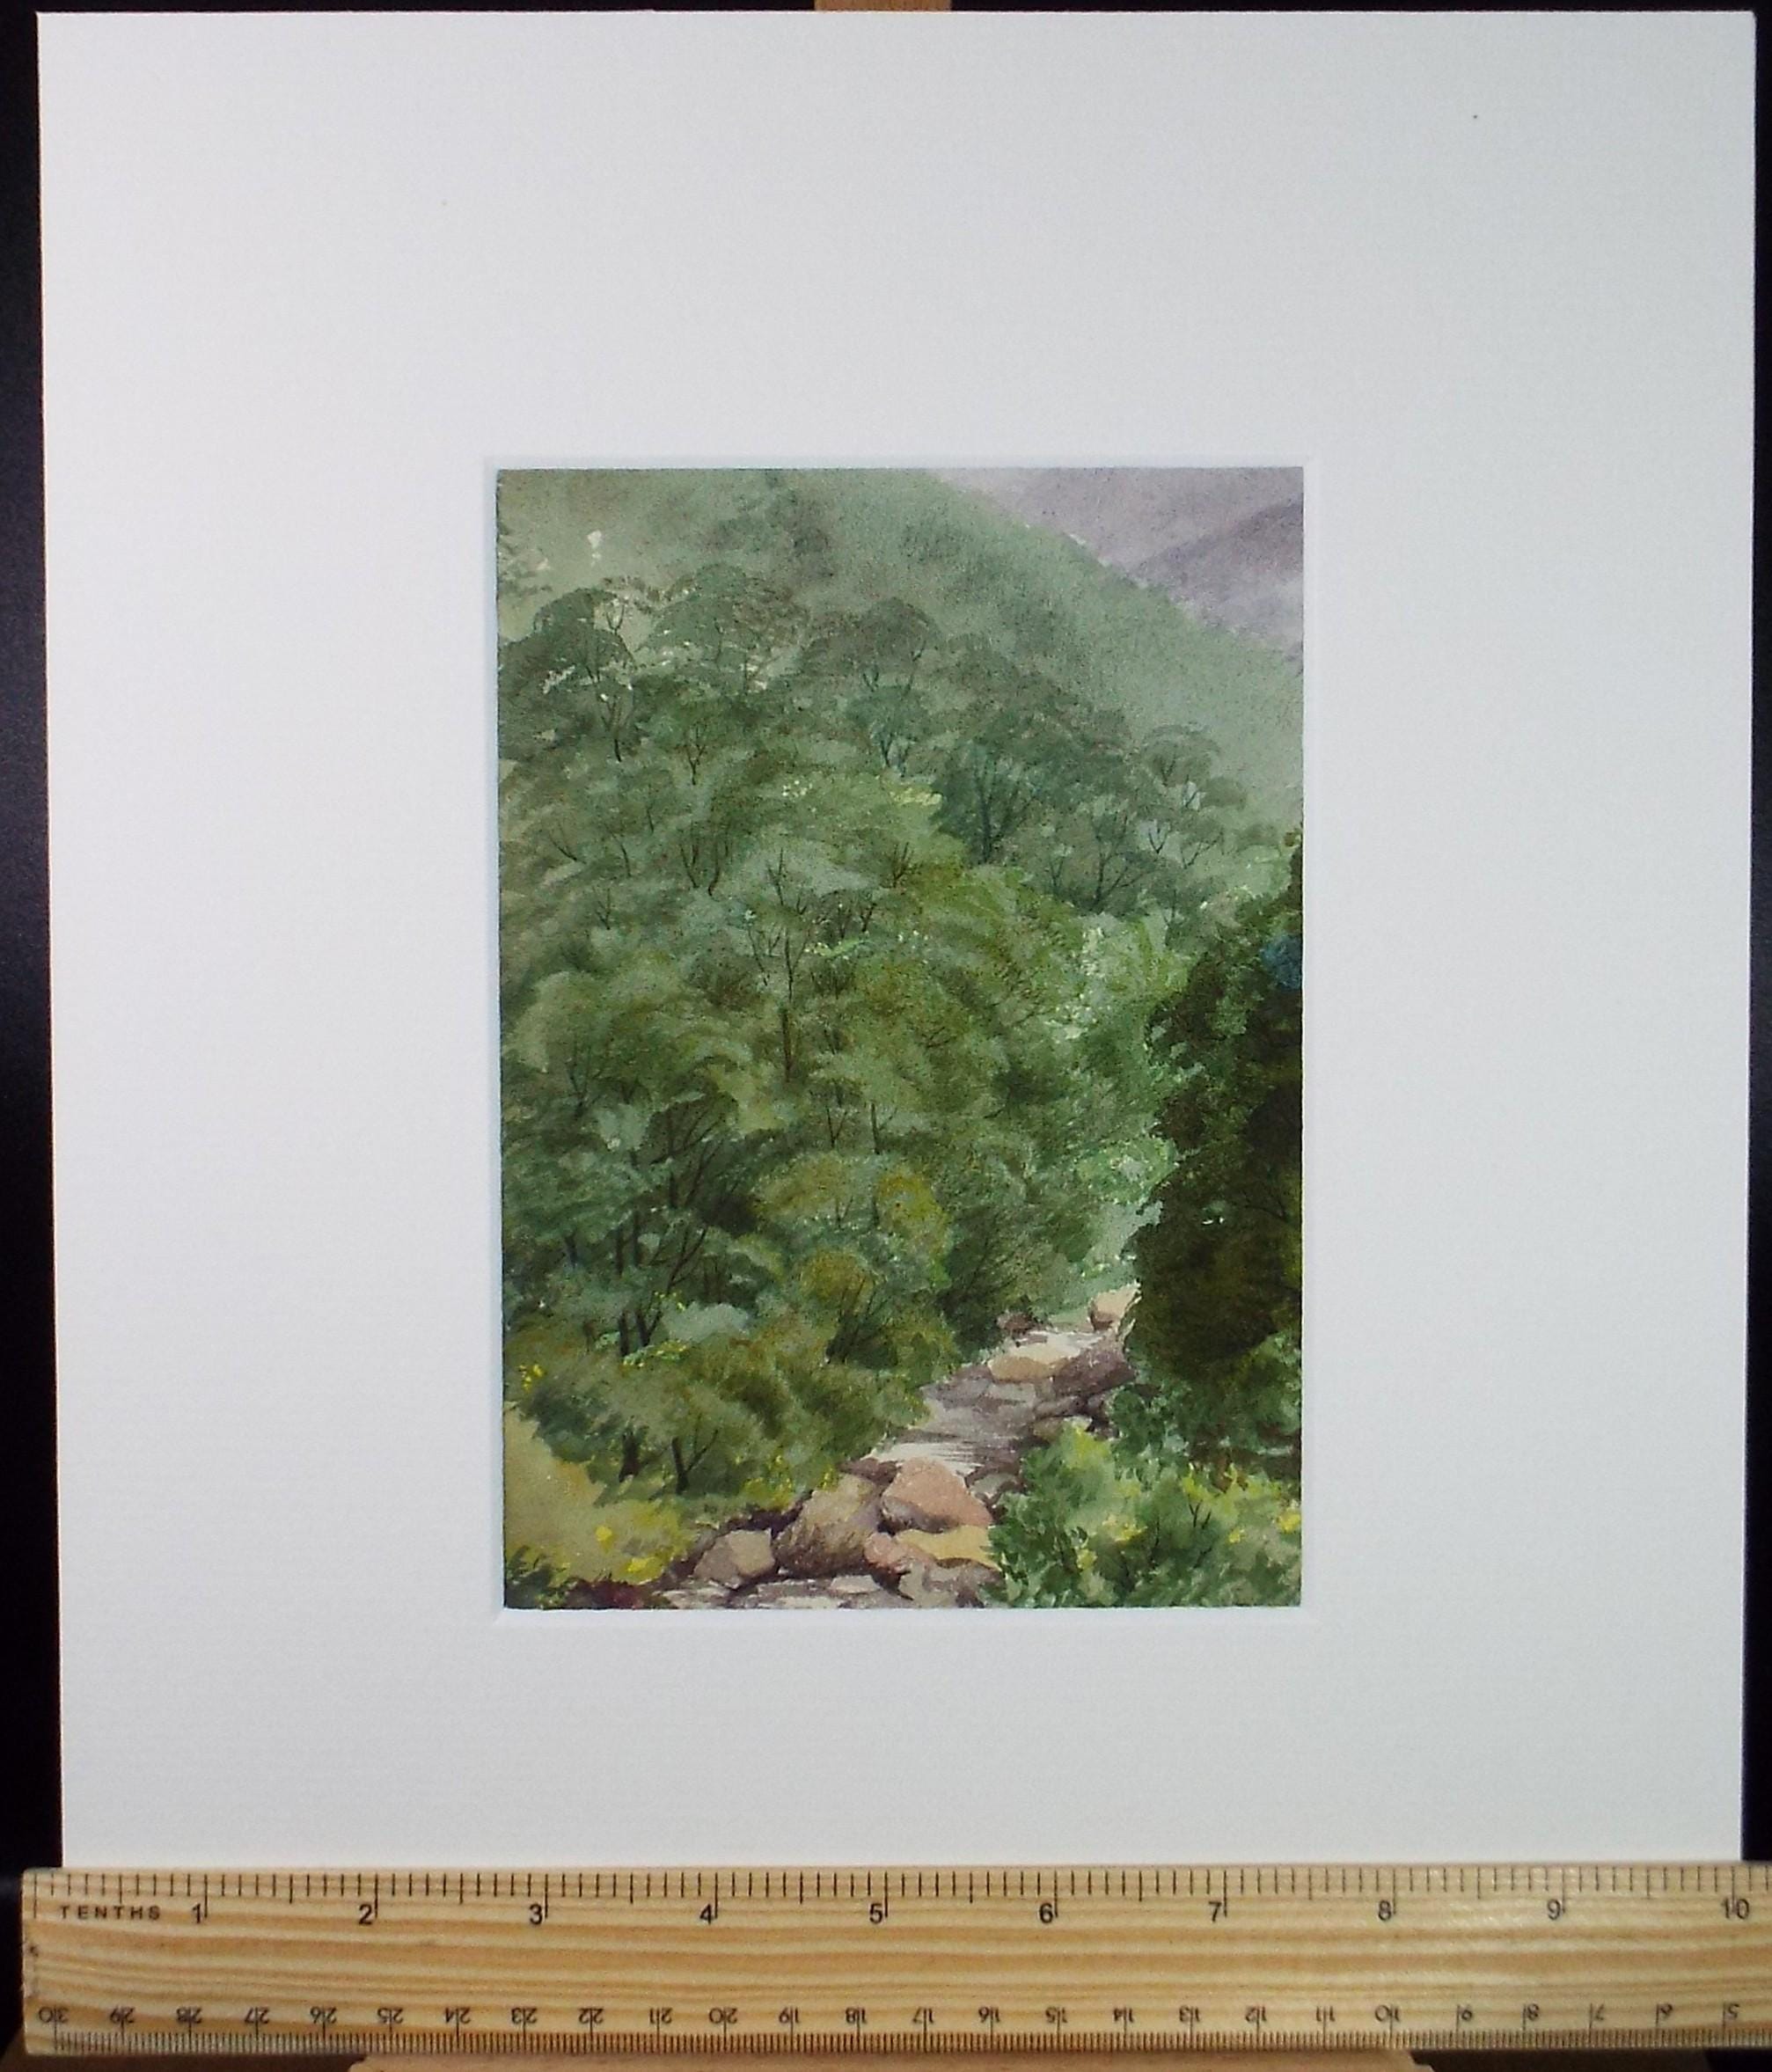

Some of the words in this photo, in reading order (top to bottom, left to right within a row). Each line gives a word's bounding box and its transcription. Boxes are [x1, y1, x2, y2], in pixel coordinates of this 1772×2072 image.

[60, 1905, 161, 1921] TENTHS
[192, 1902, 201, 1923] 1
[358, 1904, 373, 1925] 2
[529, 1904, 543, 1925] 3
[699, 1903, 713, 1924] 4
[868, 1902, 882, 1923] 5
[1038, 1902, 1053, 1923] 6
[1208, 1901, 1222, 1922] 7
[1378, 1900, 1392, 1921] 8
[1547, 1899, 1561, 1920] 9
[1721, 1898, 1750, 1920] 10
